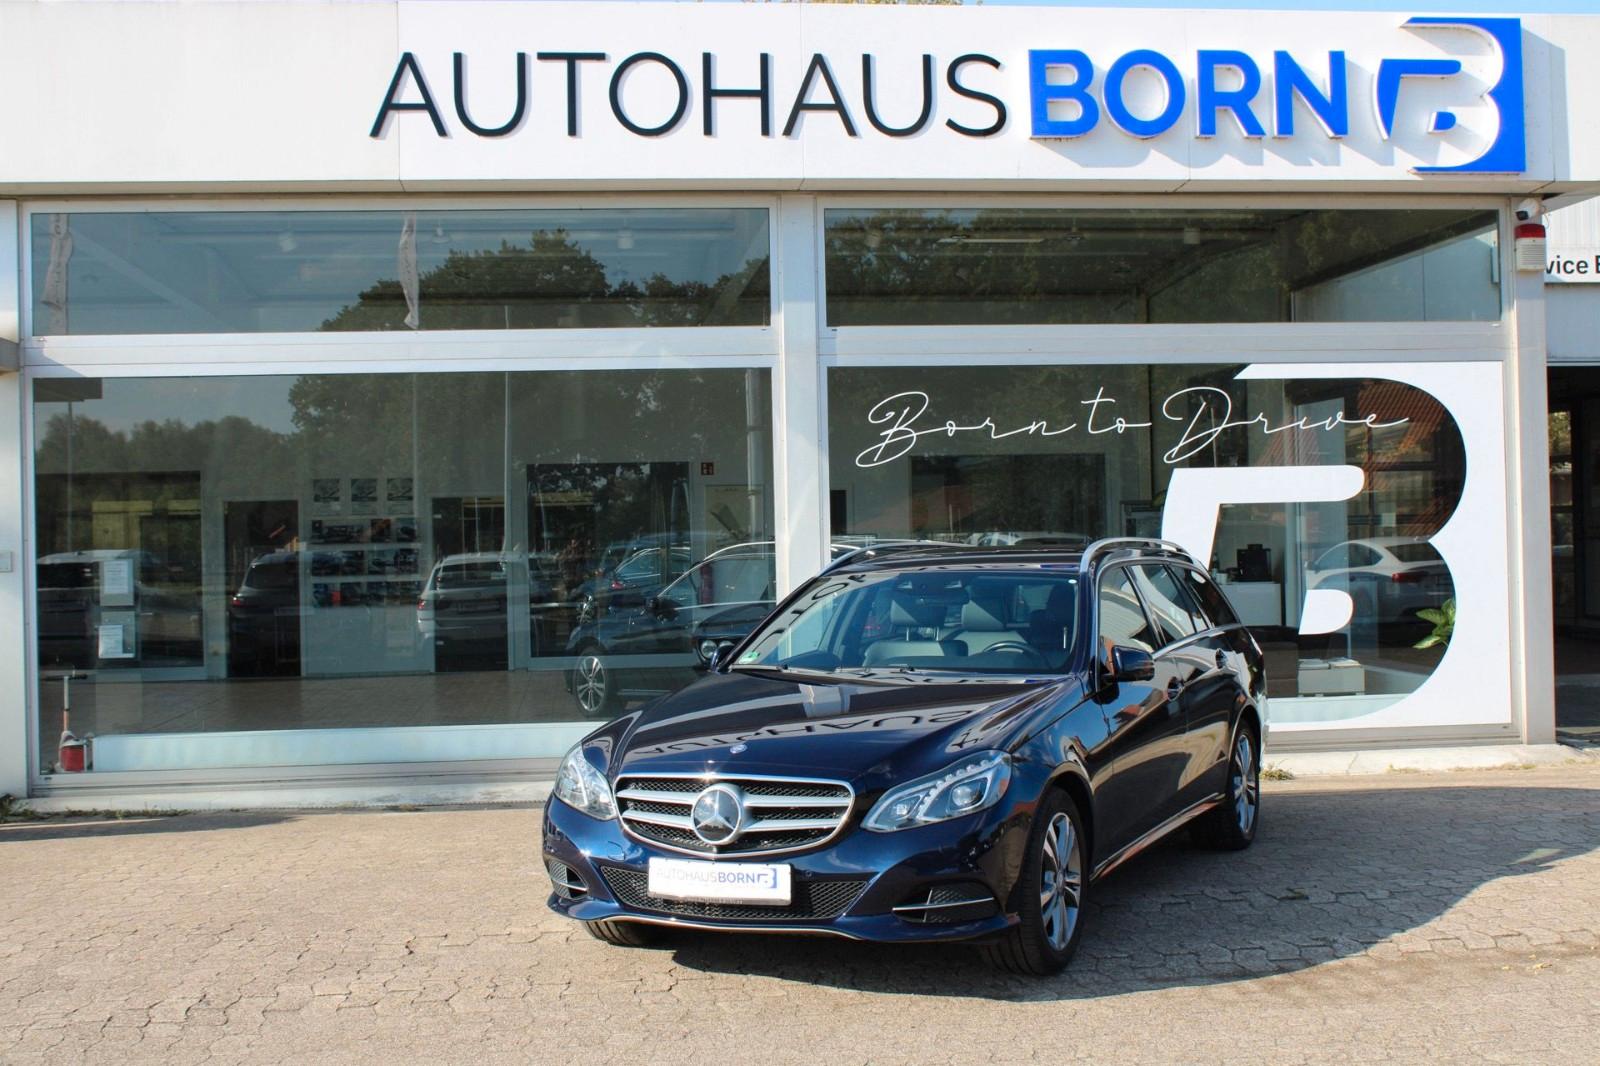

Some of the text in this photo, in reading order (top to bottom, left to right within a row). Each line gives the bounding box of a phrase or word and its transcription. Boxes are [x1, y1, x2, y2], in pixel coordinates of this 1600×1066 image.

[855, 386, 1409, 468] Born to Drive
